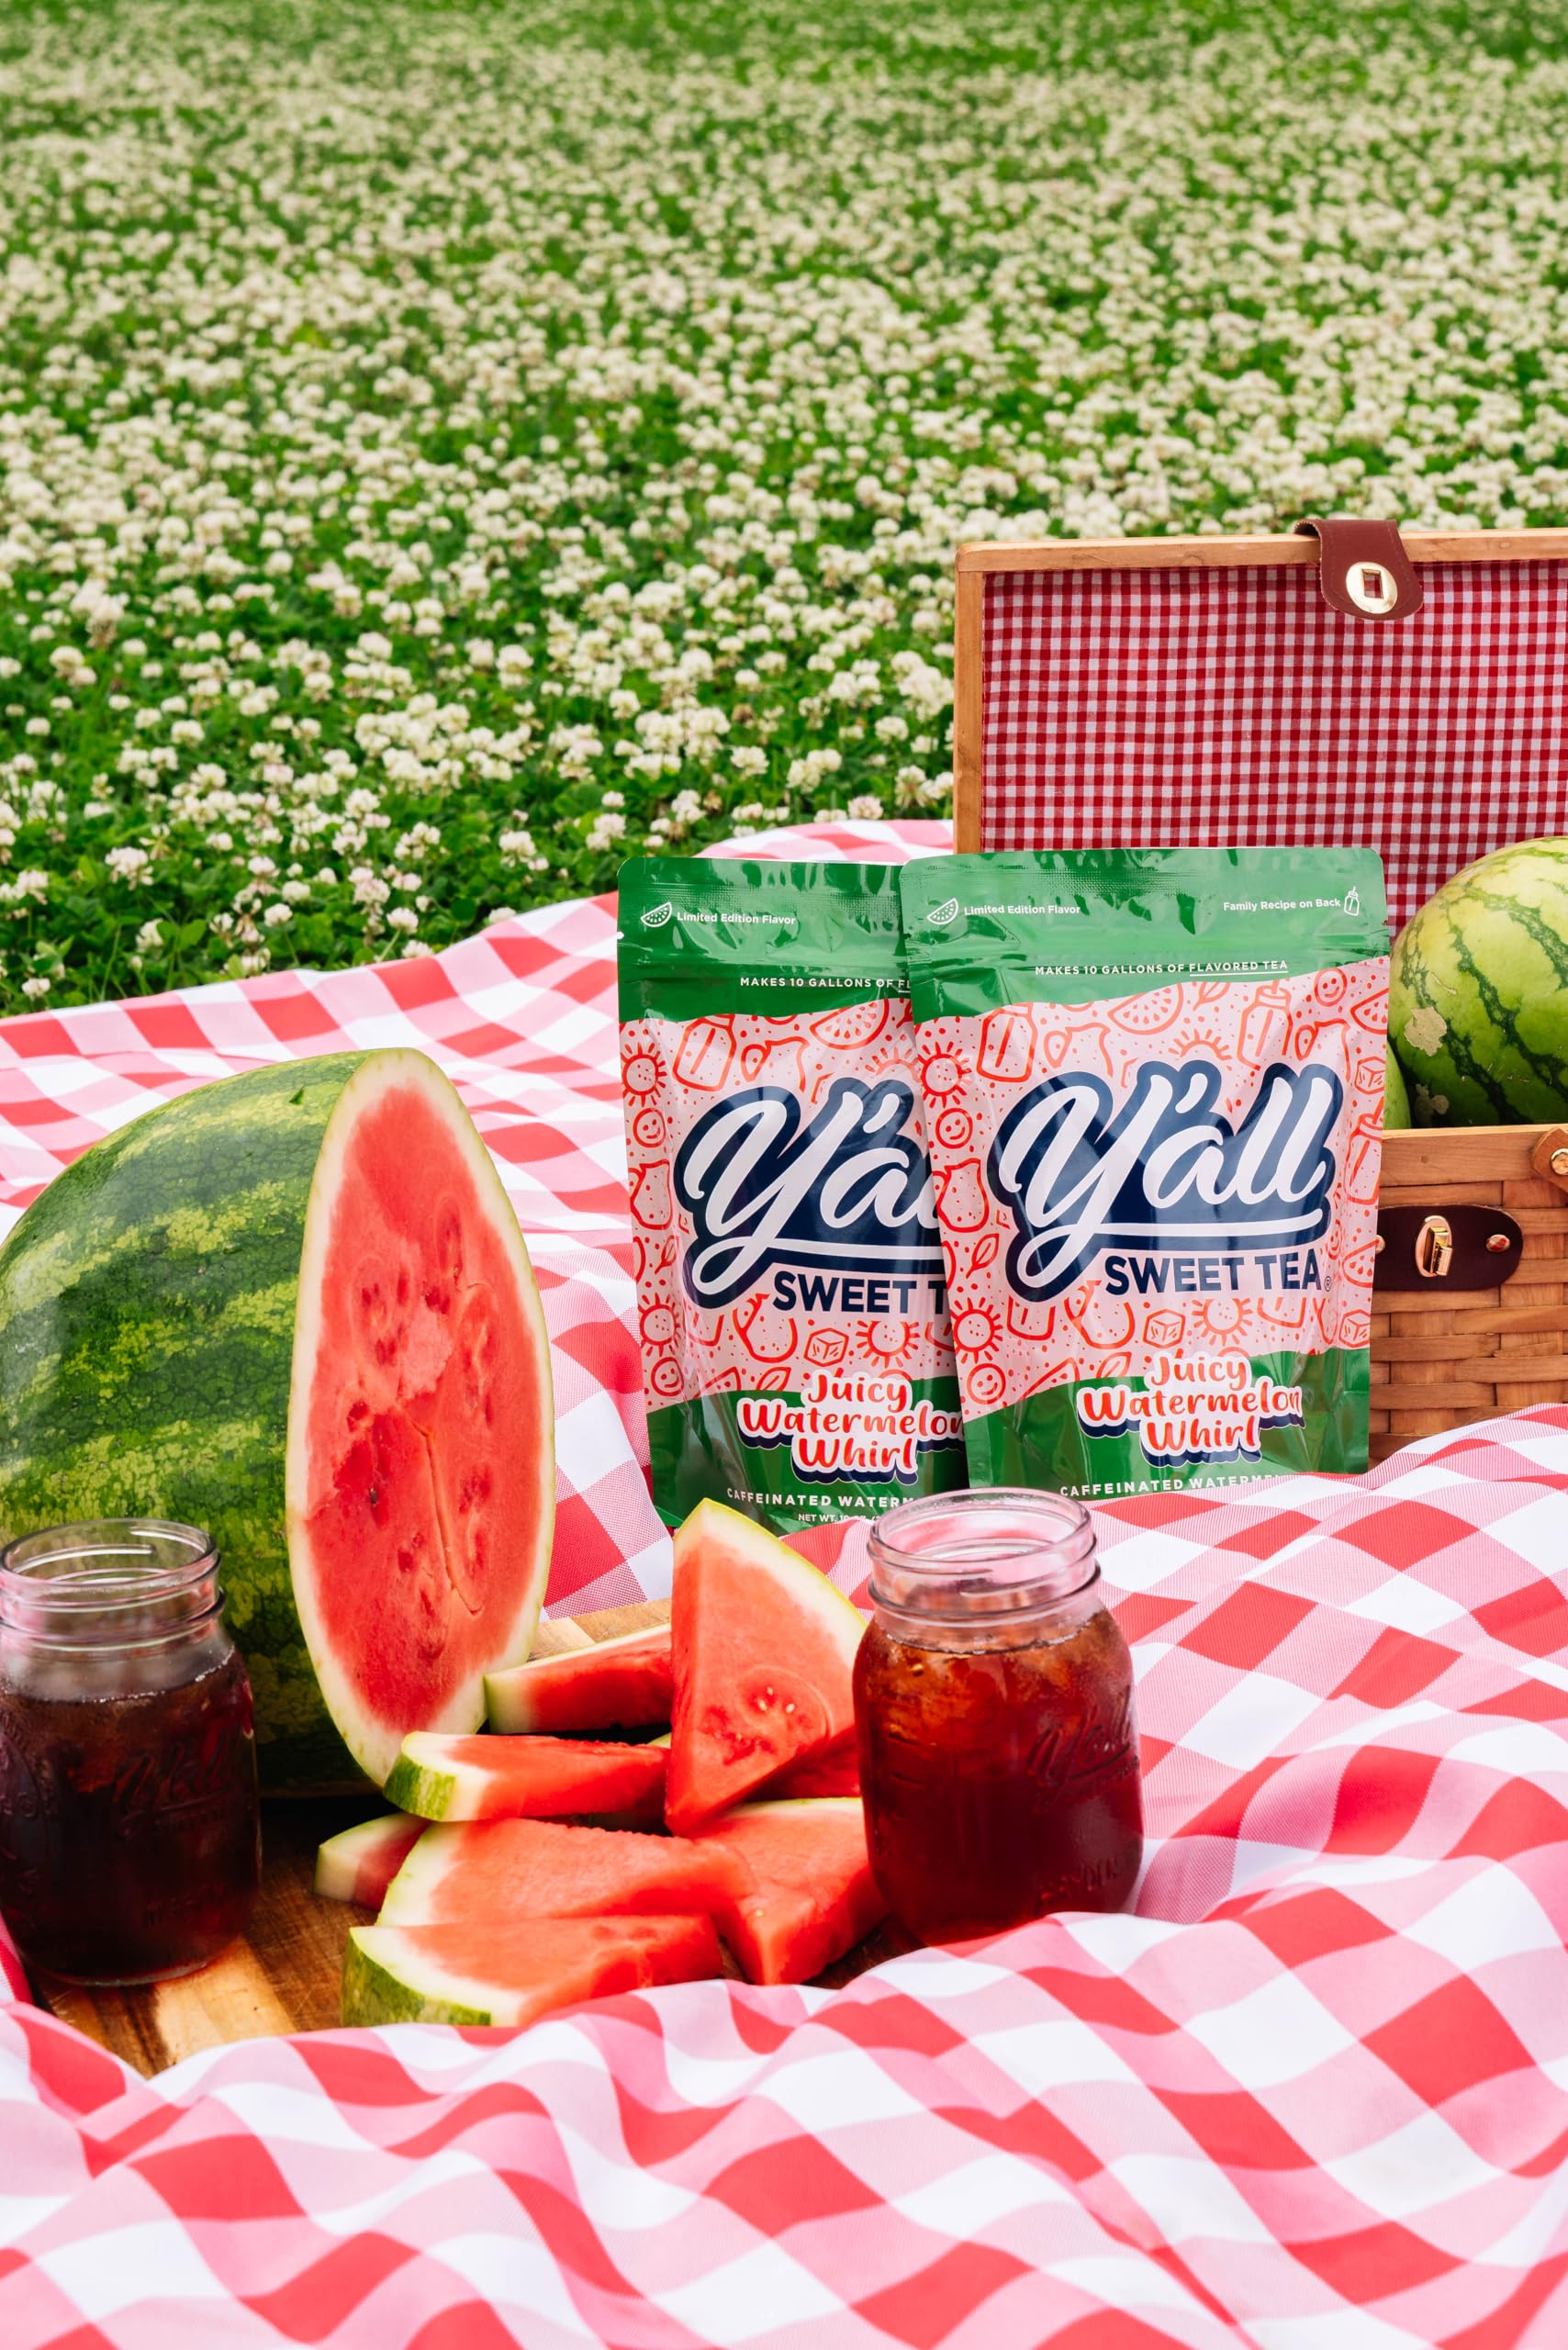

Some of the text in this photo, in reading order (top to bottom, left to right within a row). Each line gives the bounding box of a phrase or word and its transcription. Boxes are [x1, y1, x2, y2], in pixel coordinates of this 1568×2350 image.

[677, 912, 796, 925] Limited Edition Flavor
[964, 904, 1081, 916] Limited Edition Flavor
[1223, 901, 1258, 912] Family
[1260, 900, 1296, 911] Recipe
[1316, 898, 1340, 908] Back
[740, 977, 786, 987] MAKES
[790, 978, 804, 987] 10
[808, 978, 871, 988] GALLONS
[875, 979, 894, 988] OF
[1035, 960, 1289, 976] MAKES 10 GALLONS OF FLAVORED TEA
[683, 1089, 939, 1296] Y'a
[997, 1071, 1328, 1289] Y'all
[1104, 1254, 1245, 1296] SWEET
[773, 1270, 917, 1315] SWEET
[1149, 1356, 1247, 1390] Juicy
[808, 1373, 908, 1413] Juicy
[1081, 1381, 1301, 1422] Watermelon
[742, 1403, 963, 1437] Watermelon
[1145, 1416, 1258, 1452] Whirl
[798, 1437, 914, 1470] Whirl
[726, 1487, 832, 1506] CAFFEINATED
[1059, 1478, 1184, 1497] CAFFEINATED
[798, 1513, 816, 1522] NET
